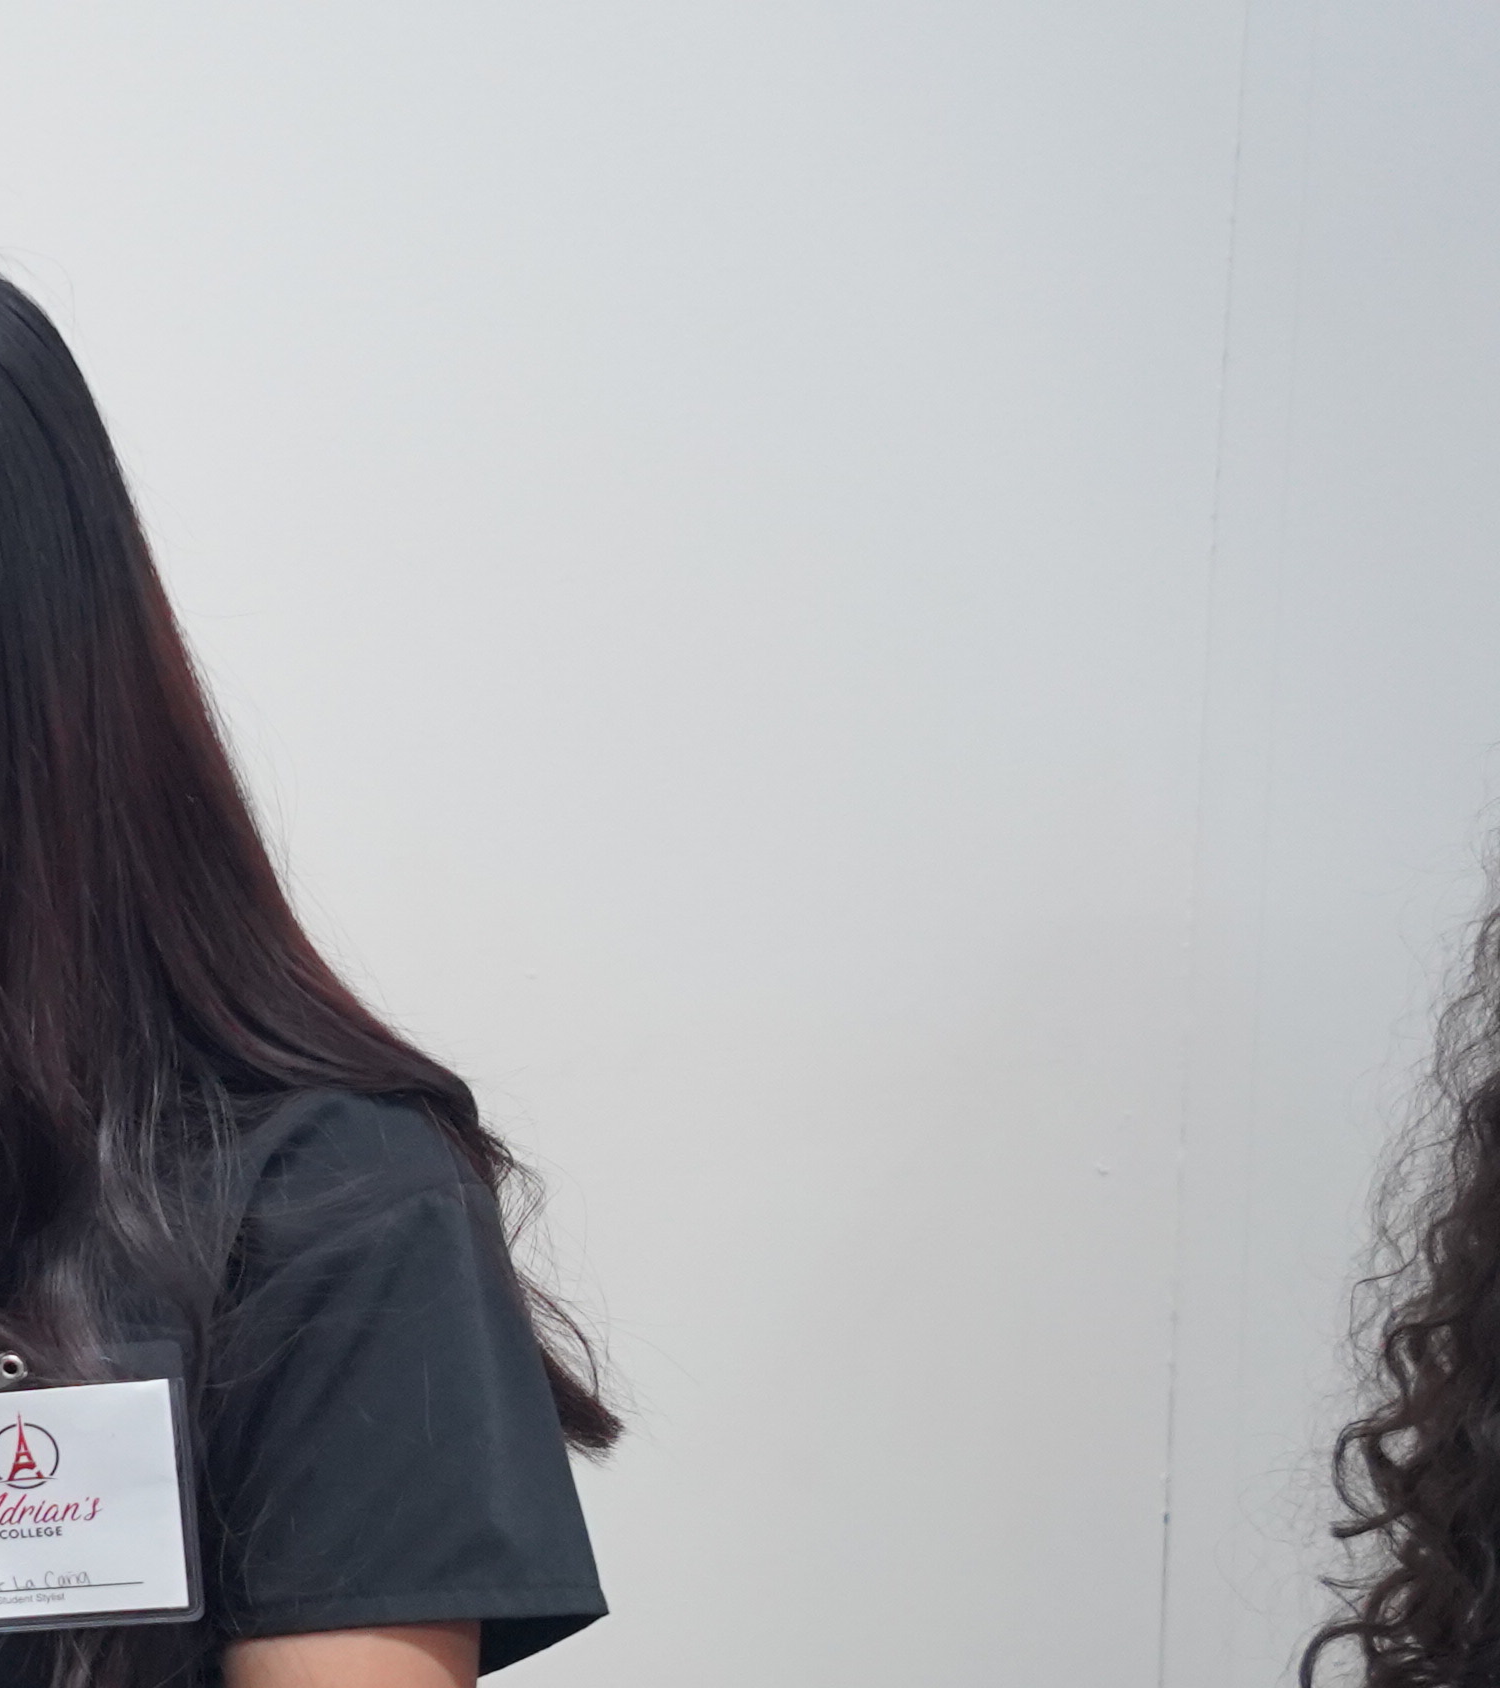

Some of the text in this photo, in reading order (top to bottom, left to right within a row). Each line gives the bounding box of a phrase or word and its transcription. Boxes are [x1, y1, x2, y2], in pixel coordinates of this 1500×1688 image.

[0, 1526, 63, 1540] COLLEGE
[12, 1575, 36, 1590] La
[36, 1592, 65, 1604] Stylist
